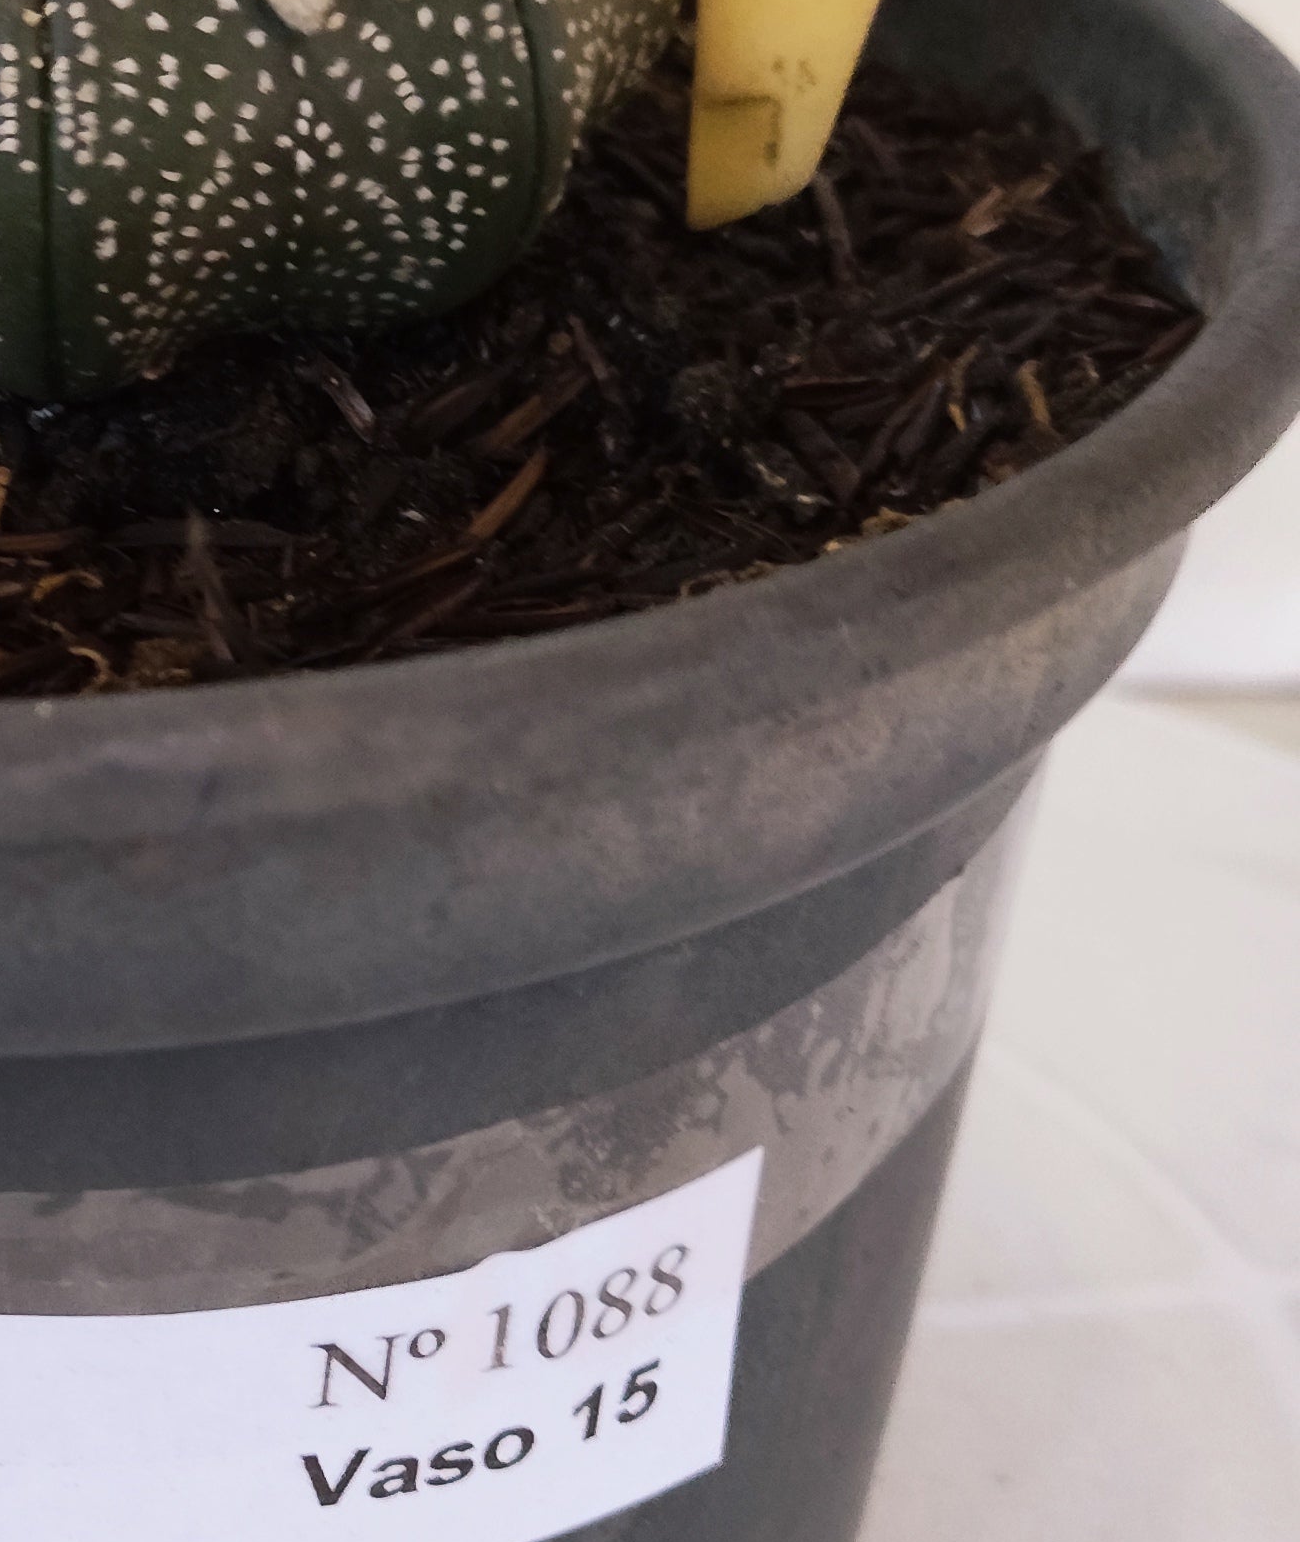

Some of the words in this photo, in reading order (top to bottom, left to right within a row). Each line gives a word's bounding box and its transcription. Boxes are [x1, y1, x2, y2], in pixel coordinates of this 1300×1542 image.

[482, 1243, 691, 1374] 1088
[300, 1425, 536, 1508] Vaso
[573, 1358, 662, 1441] 15
